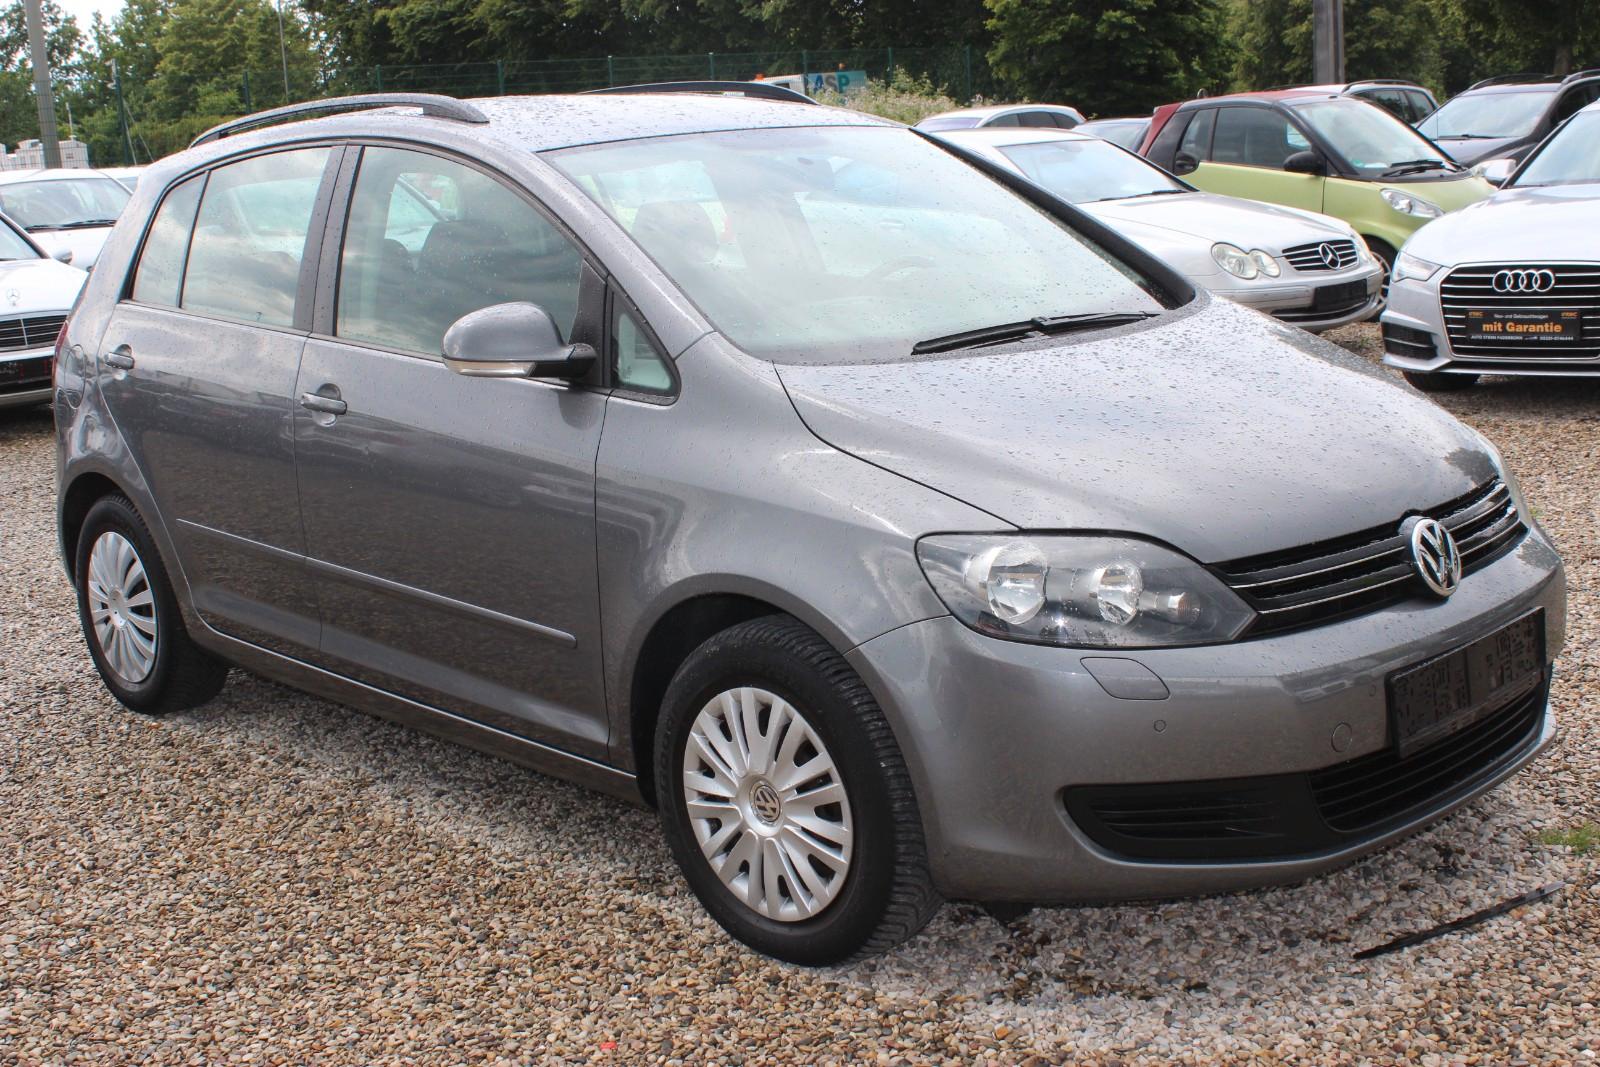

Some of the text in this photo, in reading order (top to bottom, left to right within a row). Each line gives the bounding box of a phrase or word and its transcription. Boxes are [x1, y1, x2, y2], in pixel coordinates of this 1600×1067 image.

[813, 73, 850, 93] ASP
[1482, 321, 1562, 333] mit Garantie
